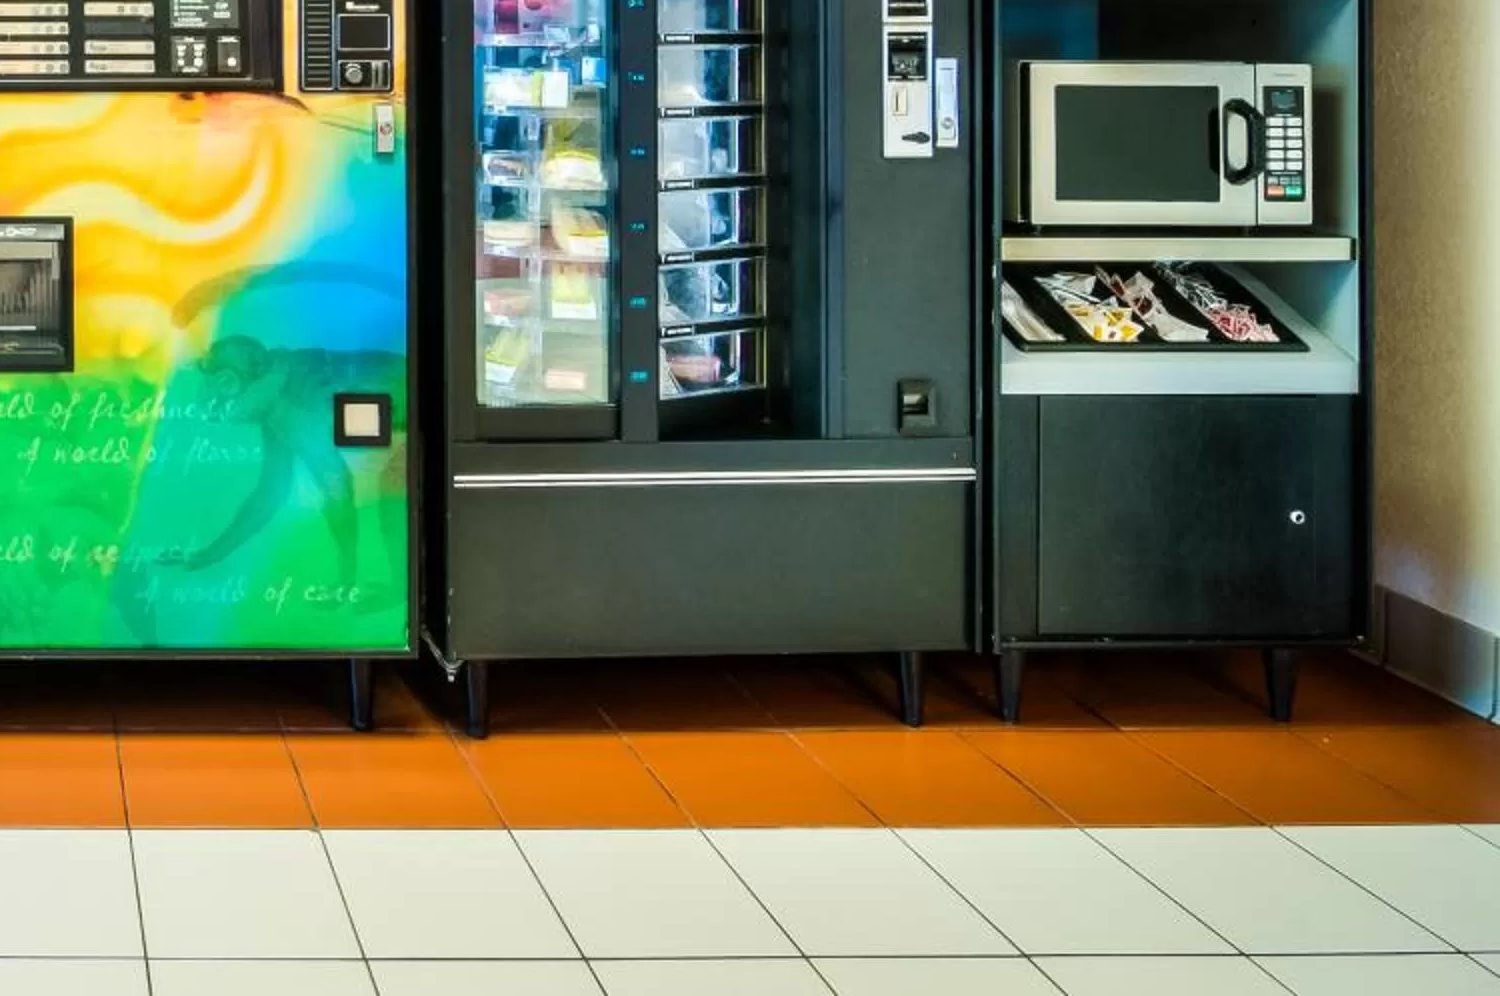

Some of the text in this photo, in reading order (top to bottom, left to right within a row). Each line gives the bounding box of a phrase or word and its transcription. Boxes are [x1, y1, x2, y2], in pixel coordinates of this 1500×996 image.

[51, 392, 81, 431] of
[53, 436, 129, 464] world
[49, 535, 78, 572] of
[264, 577, 294, 615] of
[304, 584, 361, 604] care
